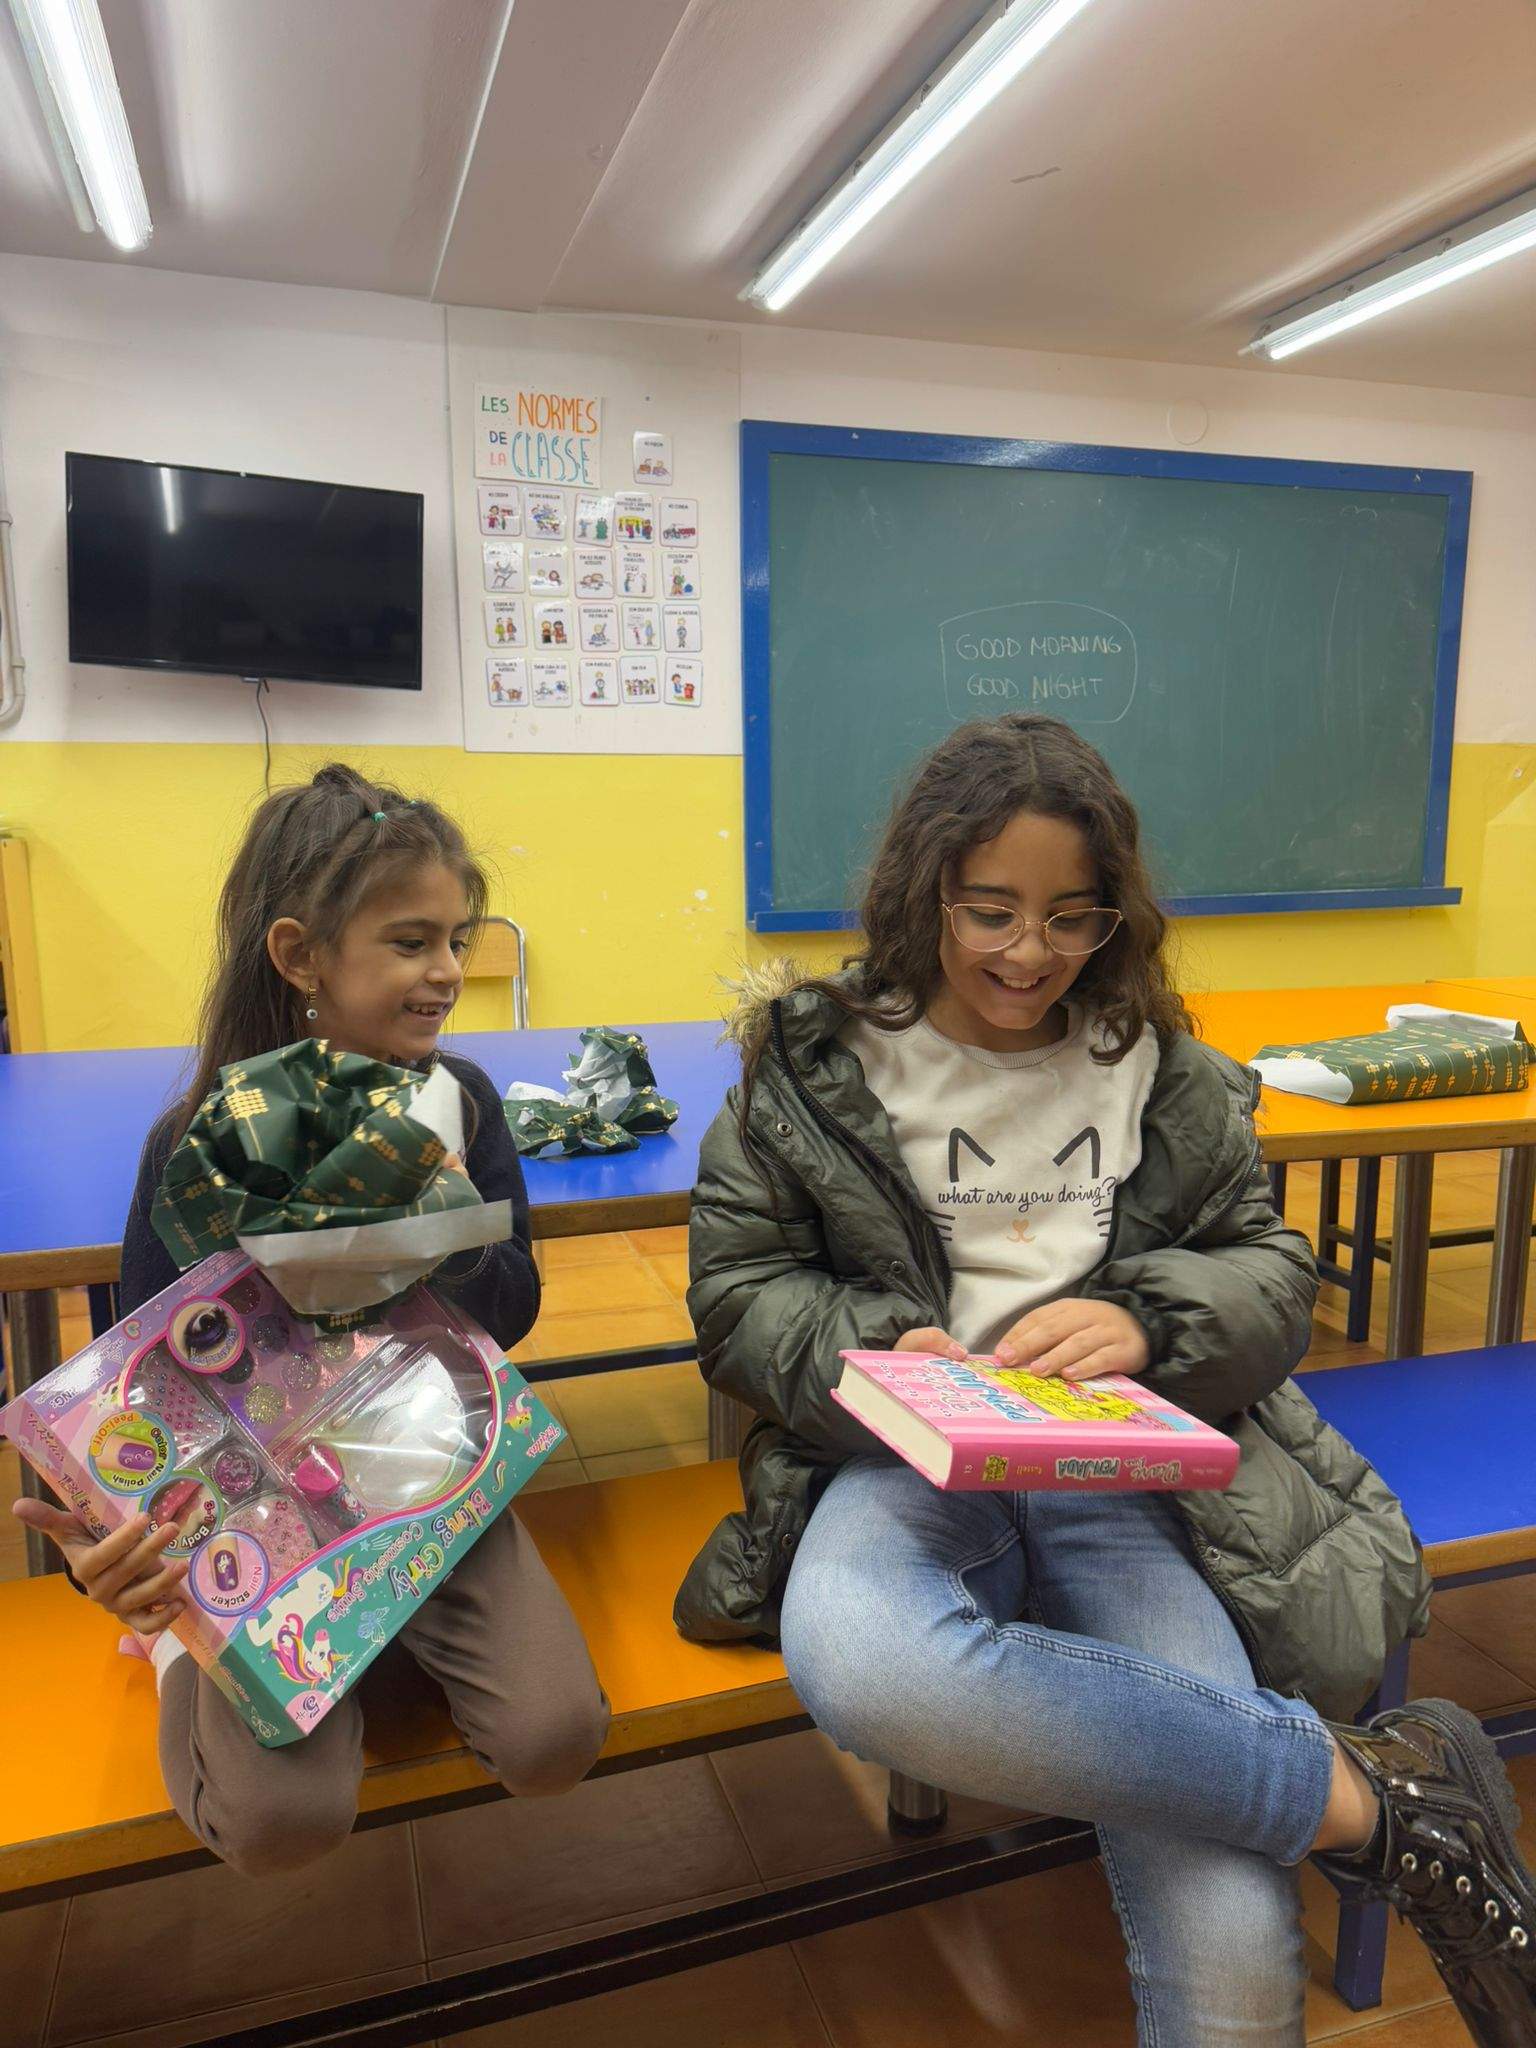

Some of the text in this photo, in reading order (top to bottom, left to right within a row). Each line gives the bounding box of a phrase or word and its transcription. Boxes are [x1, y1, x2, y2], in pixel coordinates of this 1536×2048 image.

[481, 391, 598, 434] LES NORMES
[489, 430, 508, 445] DE
[490, 431, 594, 485] LA CLASSE
[956, 634, 1121, 660] GOOD MORNING
[967, 673, 1103, 699] GOOD NIGHT
[937, 1176, 1116, 1213] what are you doing?
[929, 1359, 1043, 1422] PENJADA
[112, 1427, 168, 1488] Color Nail Polish
[1055, 1457, 1121, 1479] PENJADA
[181, 1525, 210, 1549] Body
[387, 1487, 494, 1600] Bling Girly
[211, 1566, 263, 1609] Nail sticker
[326, 1522, 424, 1623] Cosmetic Suite
[295, 1695, 320, 1720] 5+
